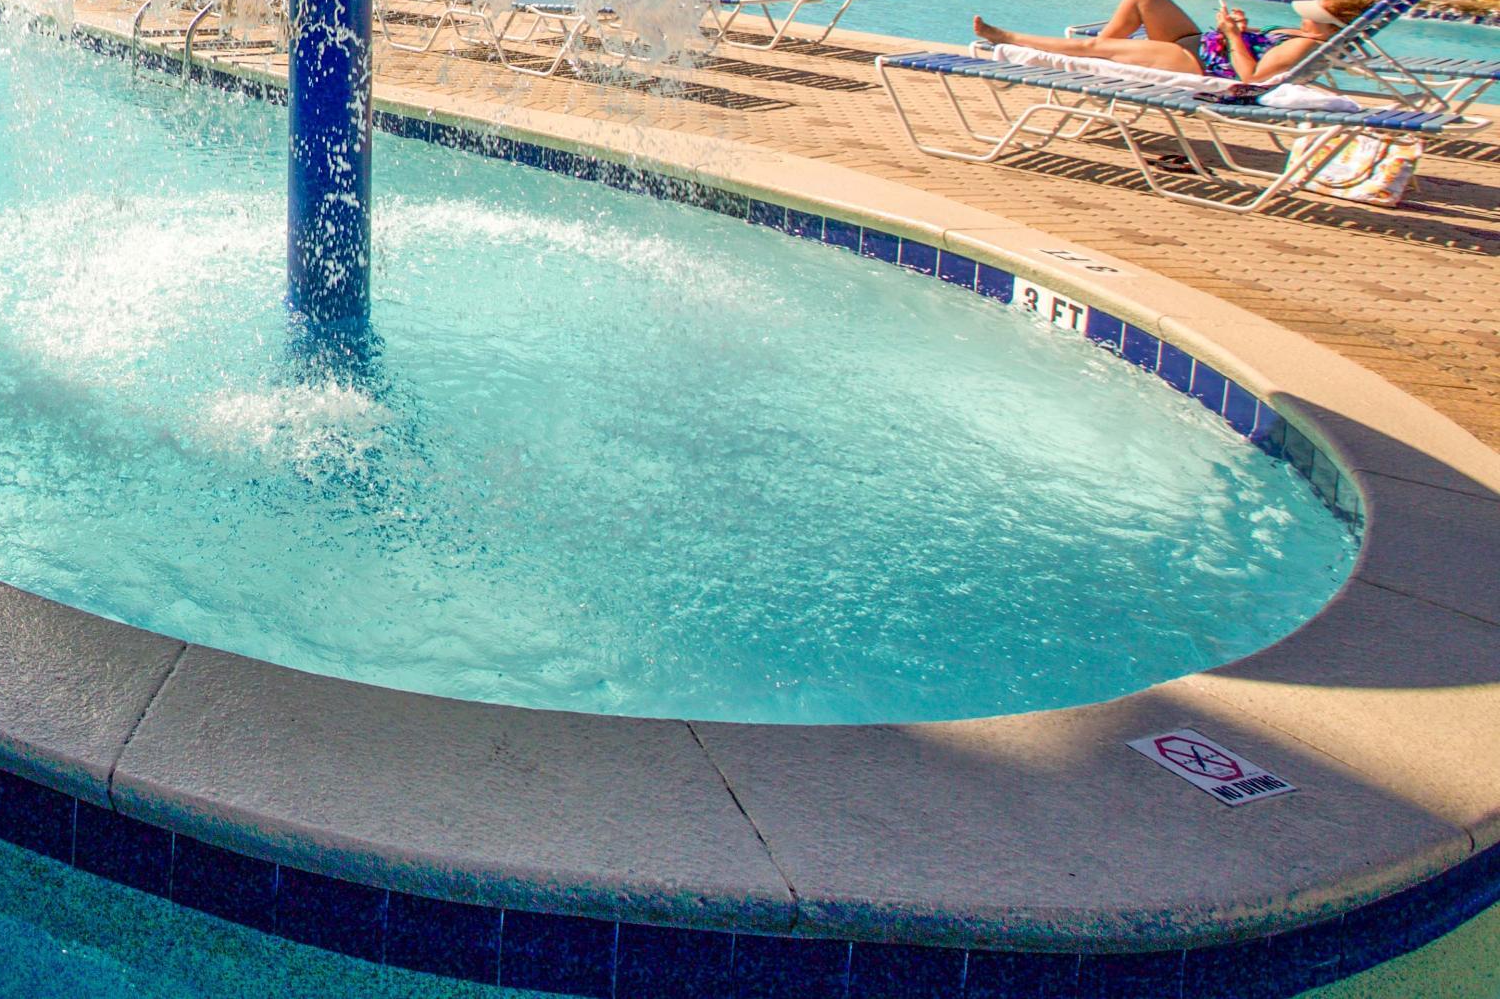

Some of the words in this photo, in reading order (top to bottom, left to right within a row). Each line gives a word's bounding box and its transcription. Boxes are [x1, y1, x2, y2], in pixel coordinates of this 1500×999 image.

[1038, 249, 1092, 262] FT
[1024, 286, 1039, 313] 3
[1050, 296, 1084, 331] FT
[1211, 784, 1244, 801] NO
[1231, 774, 1288, 796] DIVING
